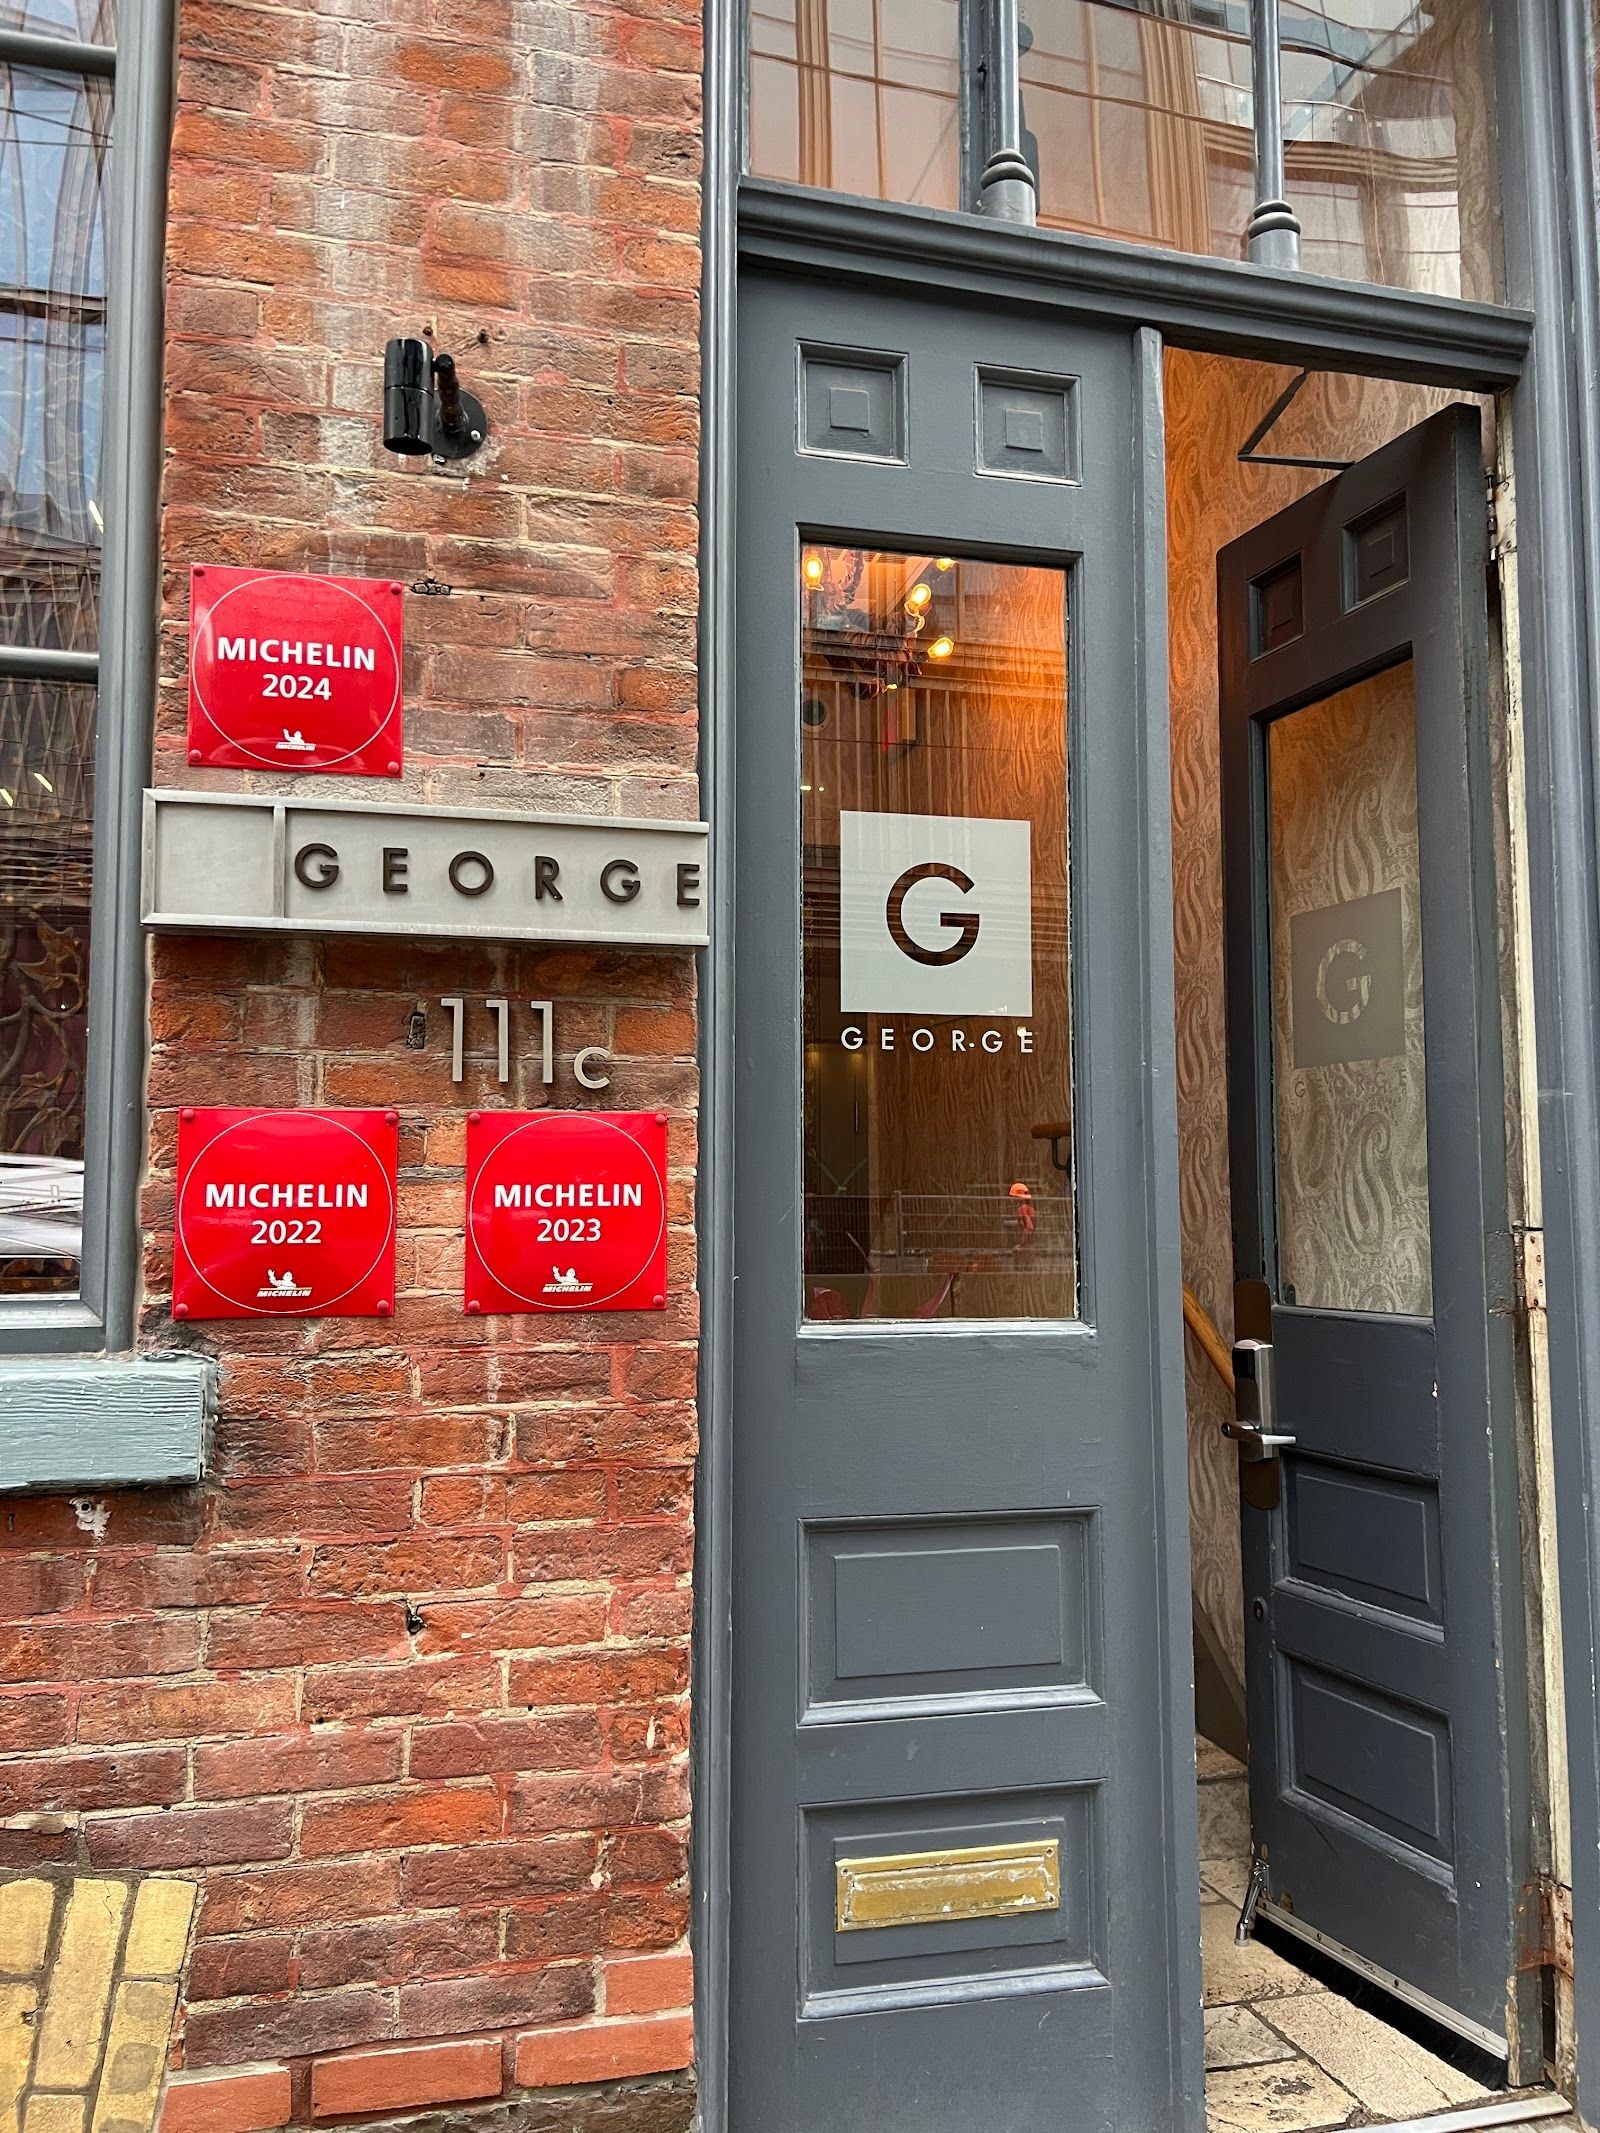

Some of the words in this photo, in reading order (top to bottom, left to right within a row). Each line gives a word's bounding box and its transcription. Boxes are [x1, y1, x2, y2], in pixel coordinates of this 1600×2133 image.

[217, 636, 375, 672] MICHELIN
[262, 673, 332, 701] 2024
[294, 842, 700, 907] GEORGE
[886, 862, 980, 966] G
[841, 1027, 1033, 1053] GEORGE
[205, 1183, 368, 1208] MICHELIN
[494, 1183, 642, 1208] MICHELIN
[250, 1219, 322, 1244] 2022
[536, 1218, 601, 1242] 2023
